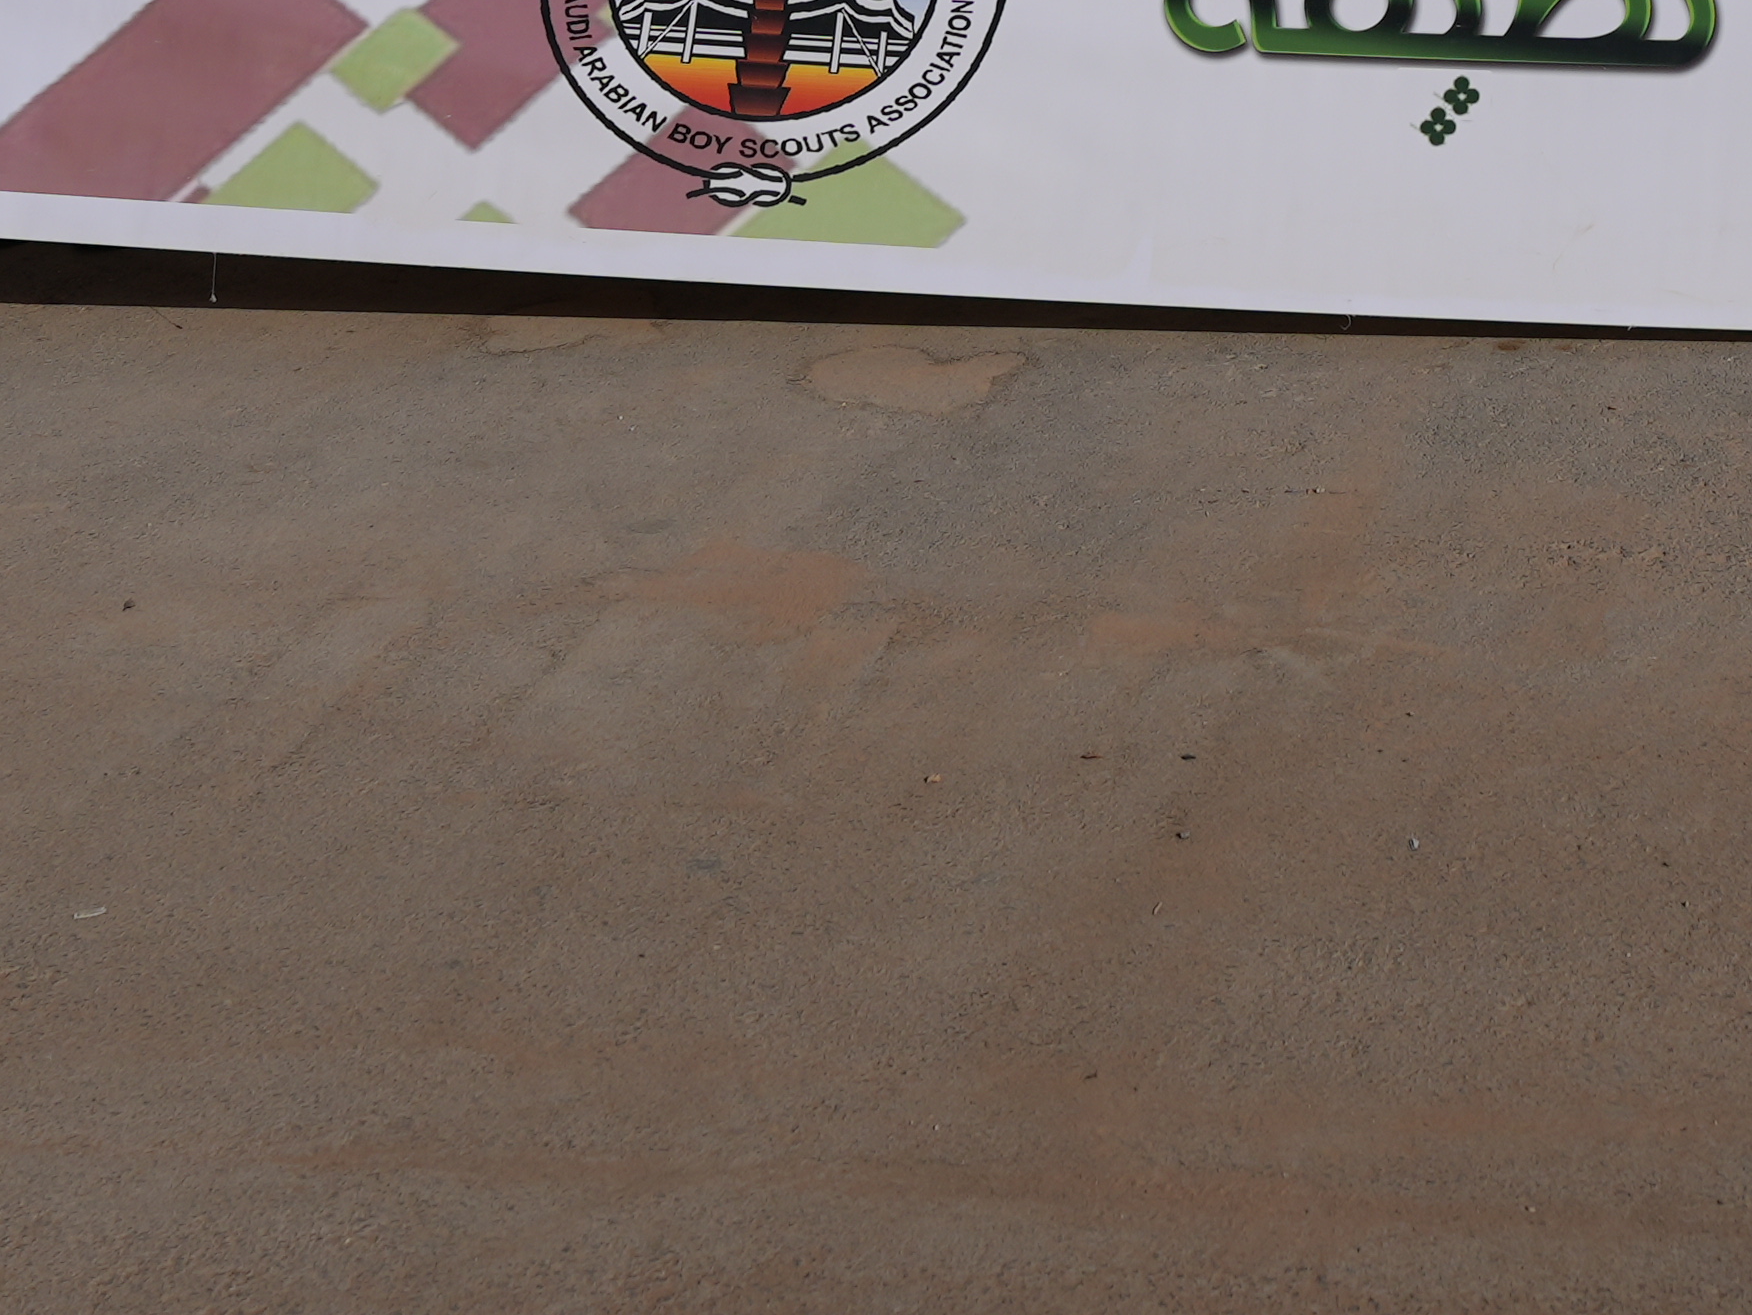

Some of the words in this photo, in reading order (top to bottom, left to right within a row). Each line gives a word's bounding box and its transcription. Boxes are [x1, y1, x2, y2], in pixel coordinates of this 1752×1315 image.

[573, 39, 668, 134] ARABIAN
[668, 122, 733, 155] BOY
[739, 123, 862, 159] SCOUTS
[866, 0, 974, 136] ASSOCIATION
